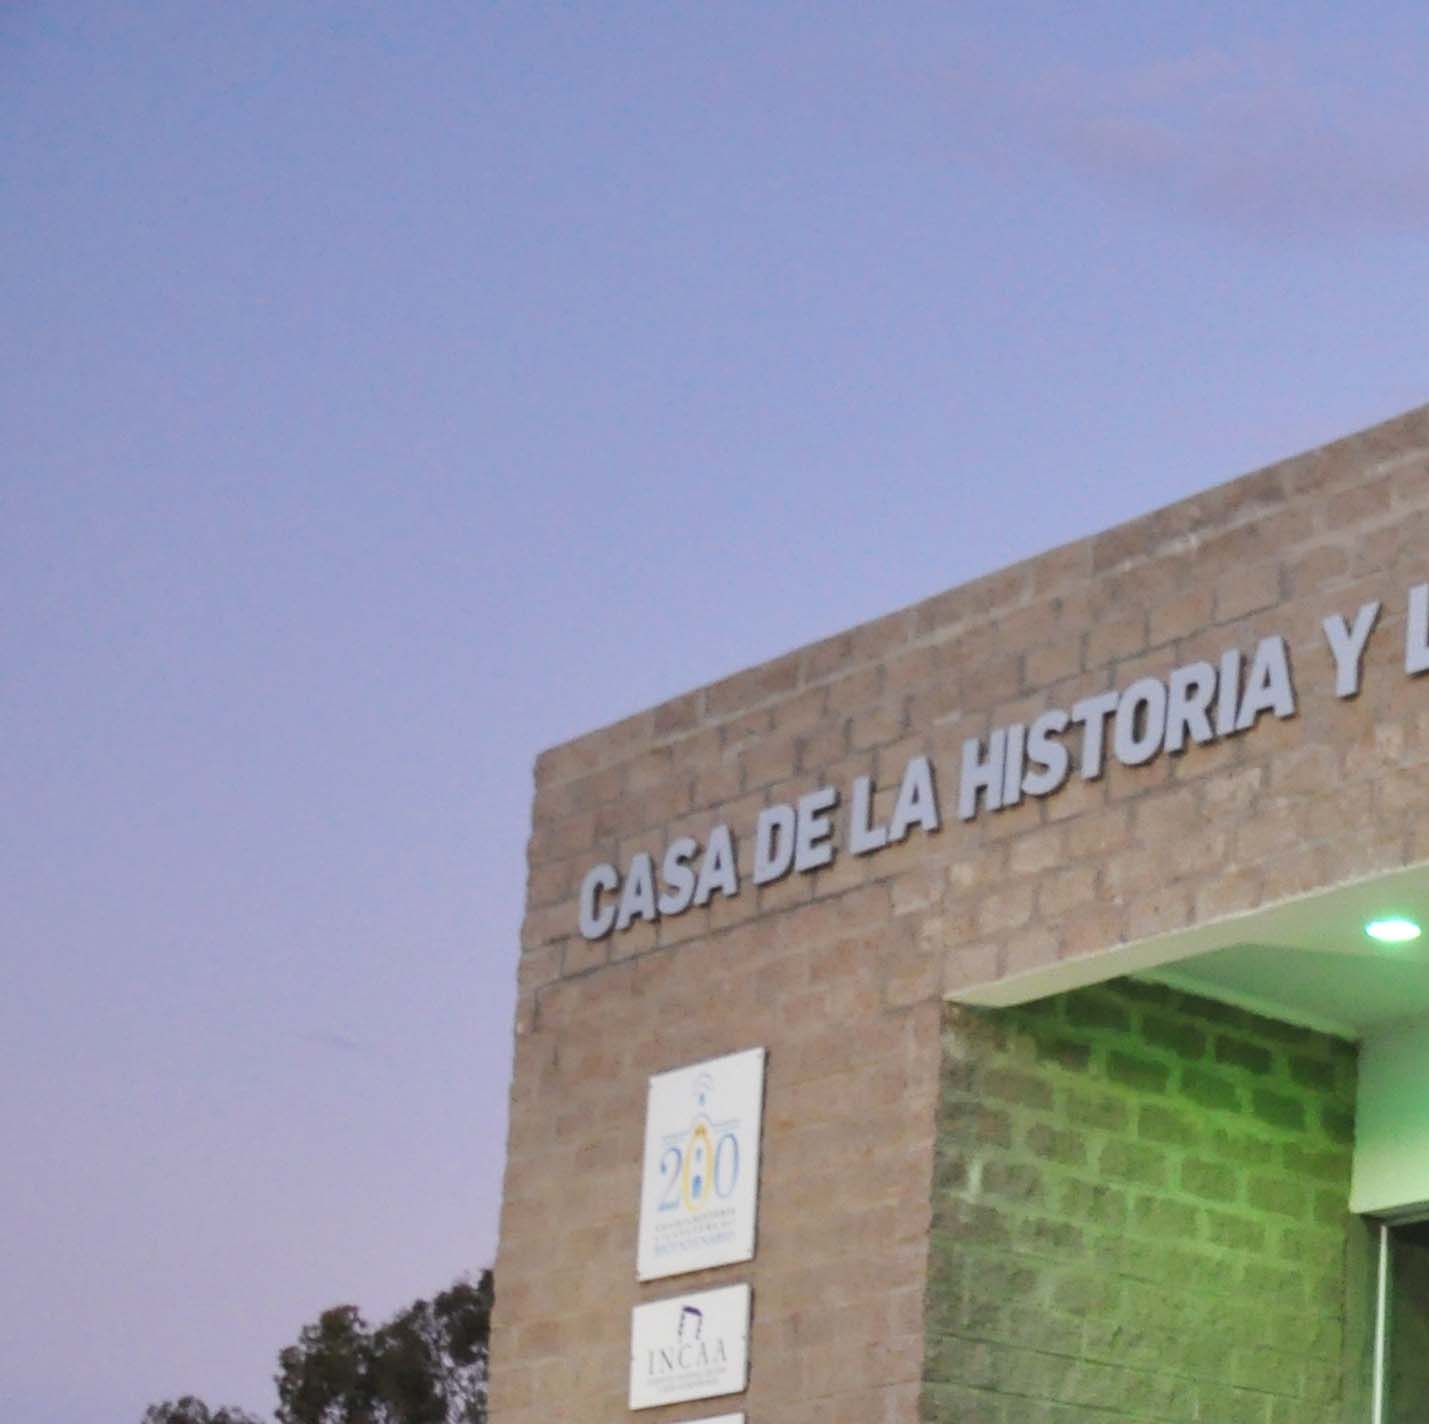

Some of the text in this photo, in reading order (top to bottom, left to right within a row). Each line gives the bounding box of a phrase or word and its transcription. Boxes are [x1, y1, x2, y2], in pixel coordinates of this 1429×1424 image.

[578, 825, 738, 940] CASA
[754, 787, 838, 884] DE
[850, 757, 939, 855] LA
[957, 636, 1296, 821] HISTORIA
[1323, 602, 1380, 698] Y
